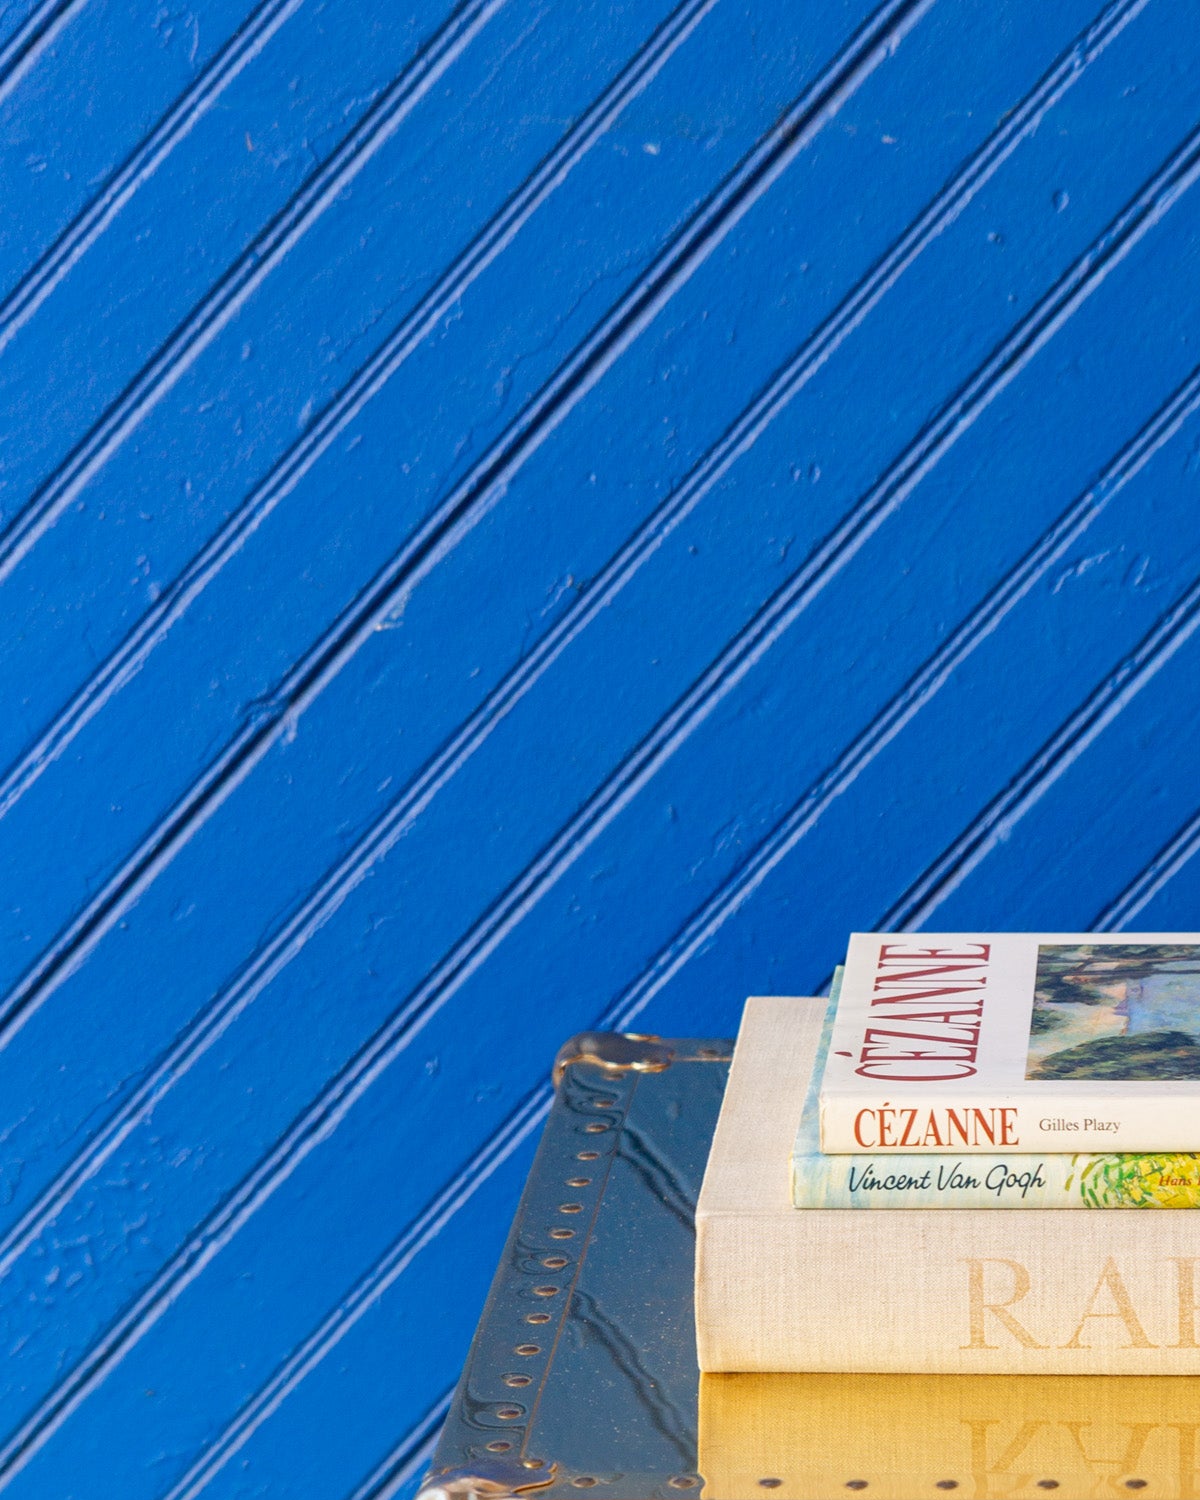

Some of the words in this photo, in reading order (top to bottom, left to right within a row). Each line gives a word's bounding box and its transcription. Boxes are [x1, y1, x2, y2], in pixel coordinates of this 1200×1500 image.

[834, 943, 991, 1081] CÉZANNE
[854, 1102, 1019, 1147] CÉZANNE
[1039, 1118, 1079, 1132] Gilles
[1083, 1118, 1121, 1134] Plazy
[849, 1163, 931, 1192] Vincent
[937, 1162, 981, 1191] Van
[985, 1163, 1046, 1199] Gogh
[1158, 1175, 1192, 1186] Hans
